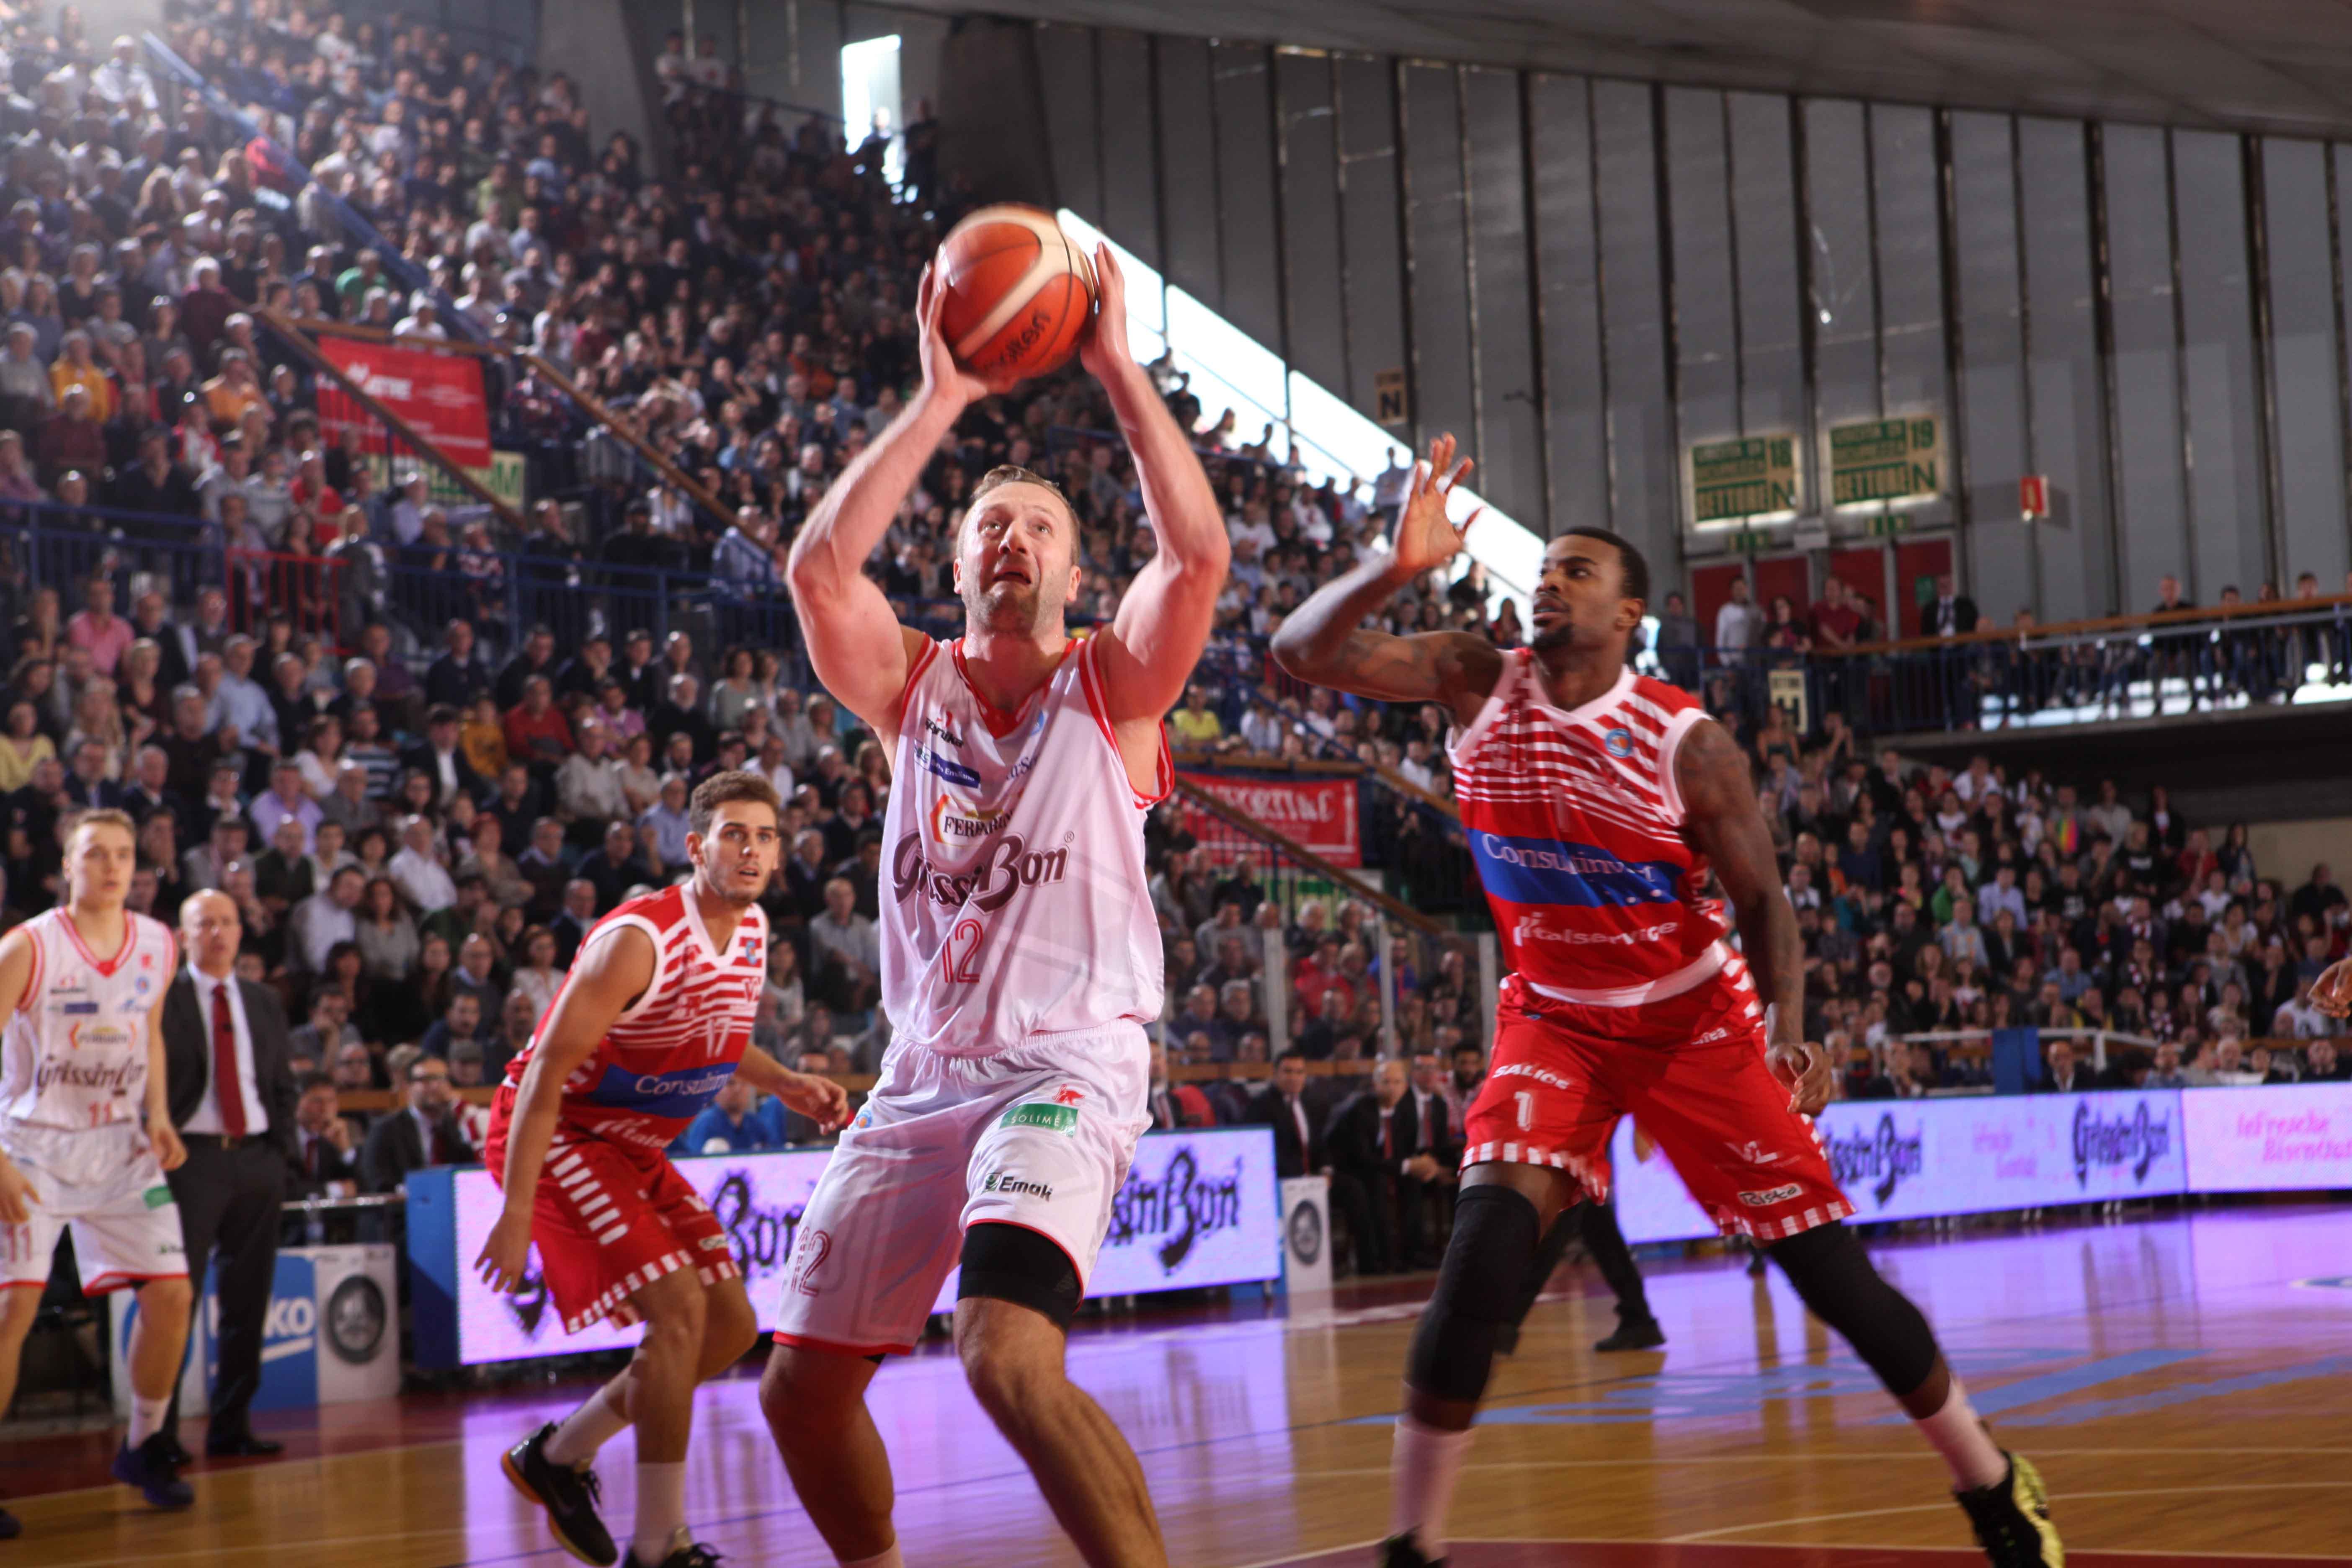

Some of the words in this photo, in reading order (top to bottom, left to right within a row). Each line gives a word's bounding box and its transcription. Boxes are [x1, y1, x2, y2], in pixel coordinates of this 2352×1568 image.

[941, 918, 984, 983] 12
[1492, 1064, 1570, 1090] SALICE
[88, 1101, 112, 1127] 11
[1514, 1090, 1534, 1132] 1
[999, 1176, 1053, 1202] Emak
[790, 1226, 832, 1298] 12
